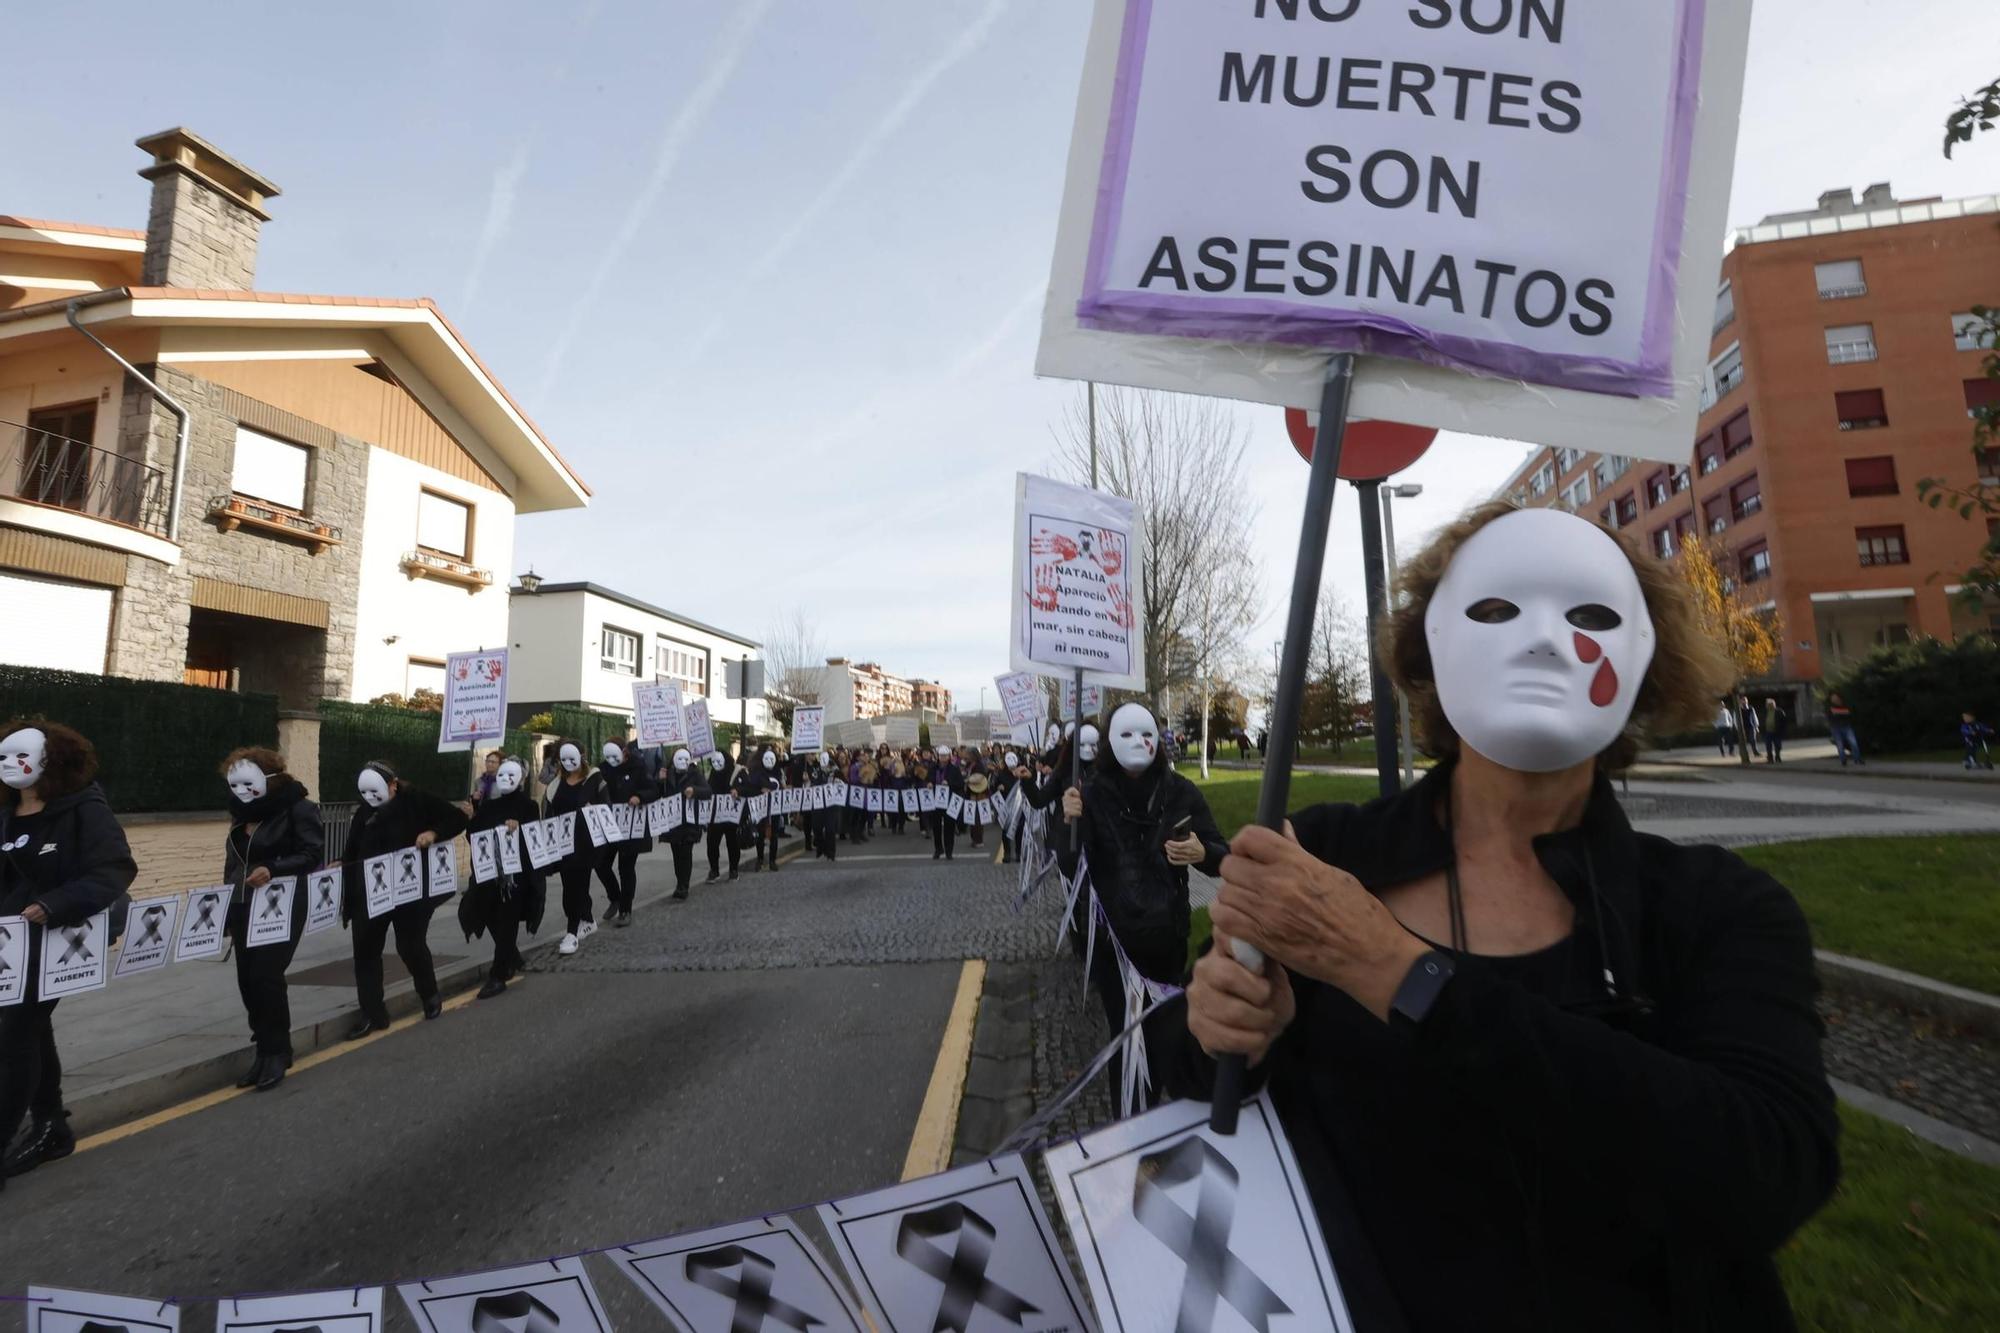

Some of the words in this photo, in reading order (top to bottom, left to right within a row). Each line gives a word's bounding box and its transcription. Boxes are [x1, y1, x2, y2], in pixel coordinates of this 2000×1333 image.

[1218, 52, 1583, 134] MUERTES
[1300, 145, 1480, 219] SON
[1137, 236, 1616, 336] ASESINATOS
[1055, 564, 1106, 585] NATALIA
[1056, 584, 1107, 602] Apareció
[1094, 611, 1108, 622] en
[1033, 620, 1062, 633] mar,
[1066, 624, 1084, 636] sin
[1088, 628, 1126, 645] cabeza
[1055, 641, 1067, 653] ni
[1071, 645, 1110, 660] manos
[458, 682, 496, 691] Asesinada
[256, 924, 284, 935] AUSENTE
[185, 937, 215, 948] AUSENTE
[126, 952, 161, 965] AUSENTE
[53, 969, 97, 985] AUSENTE
